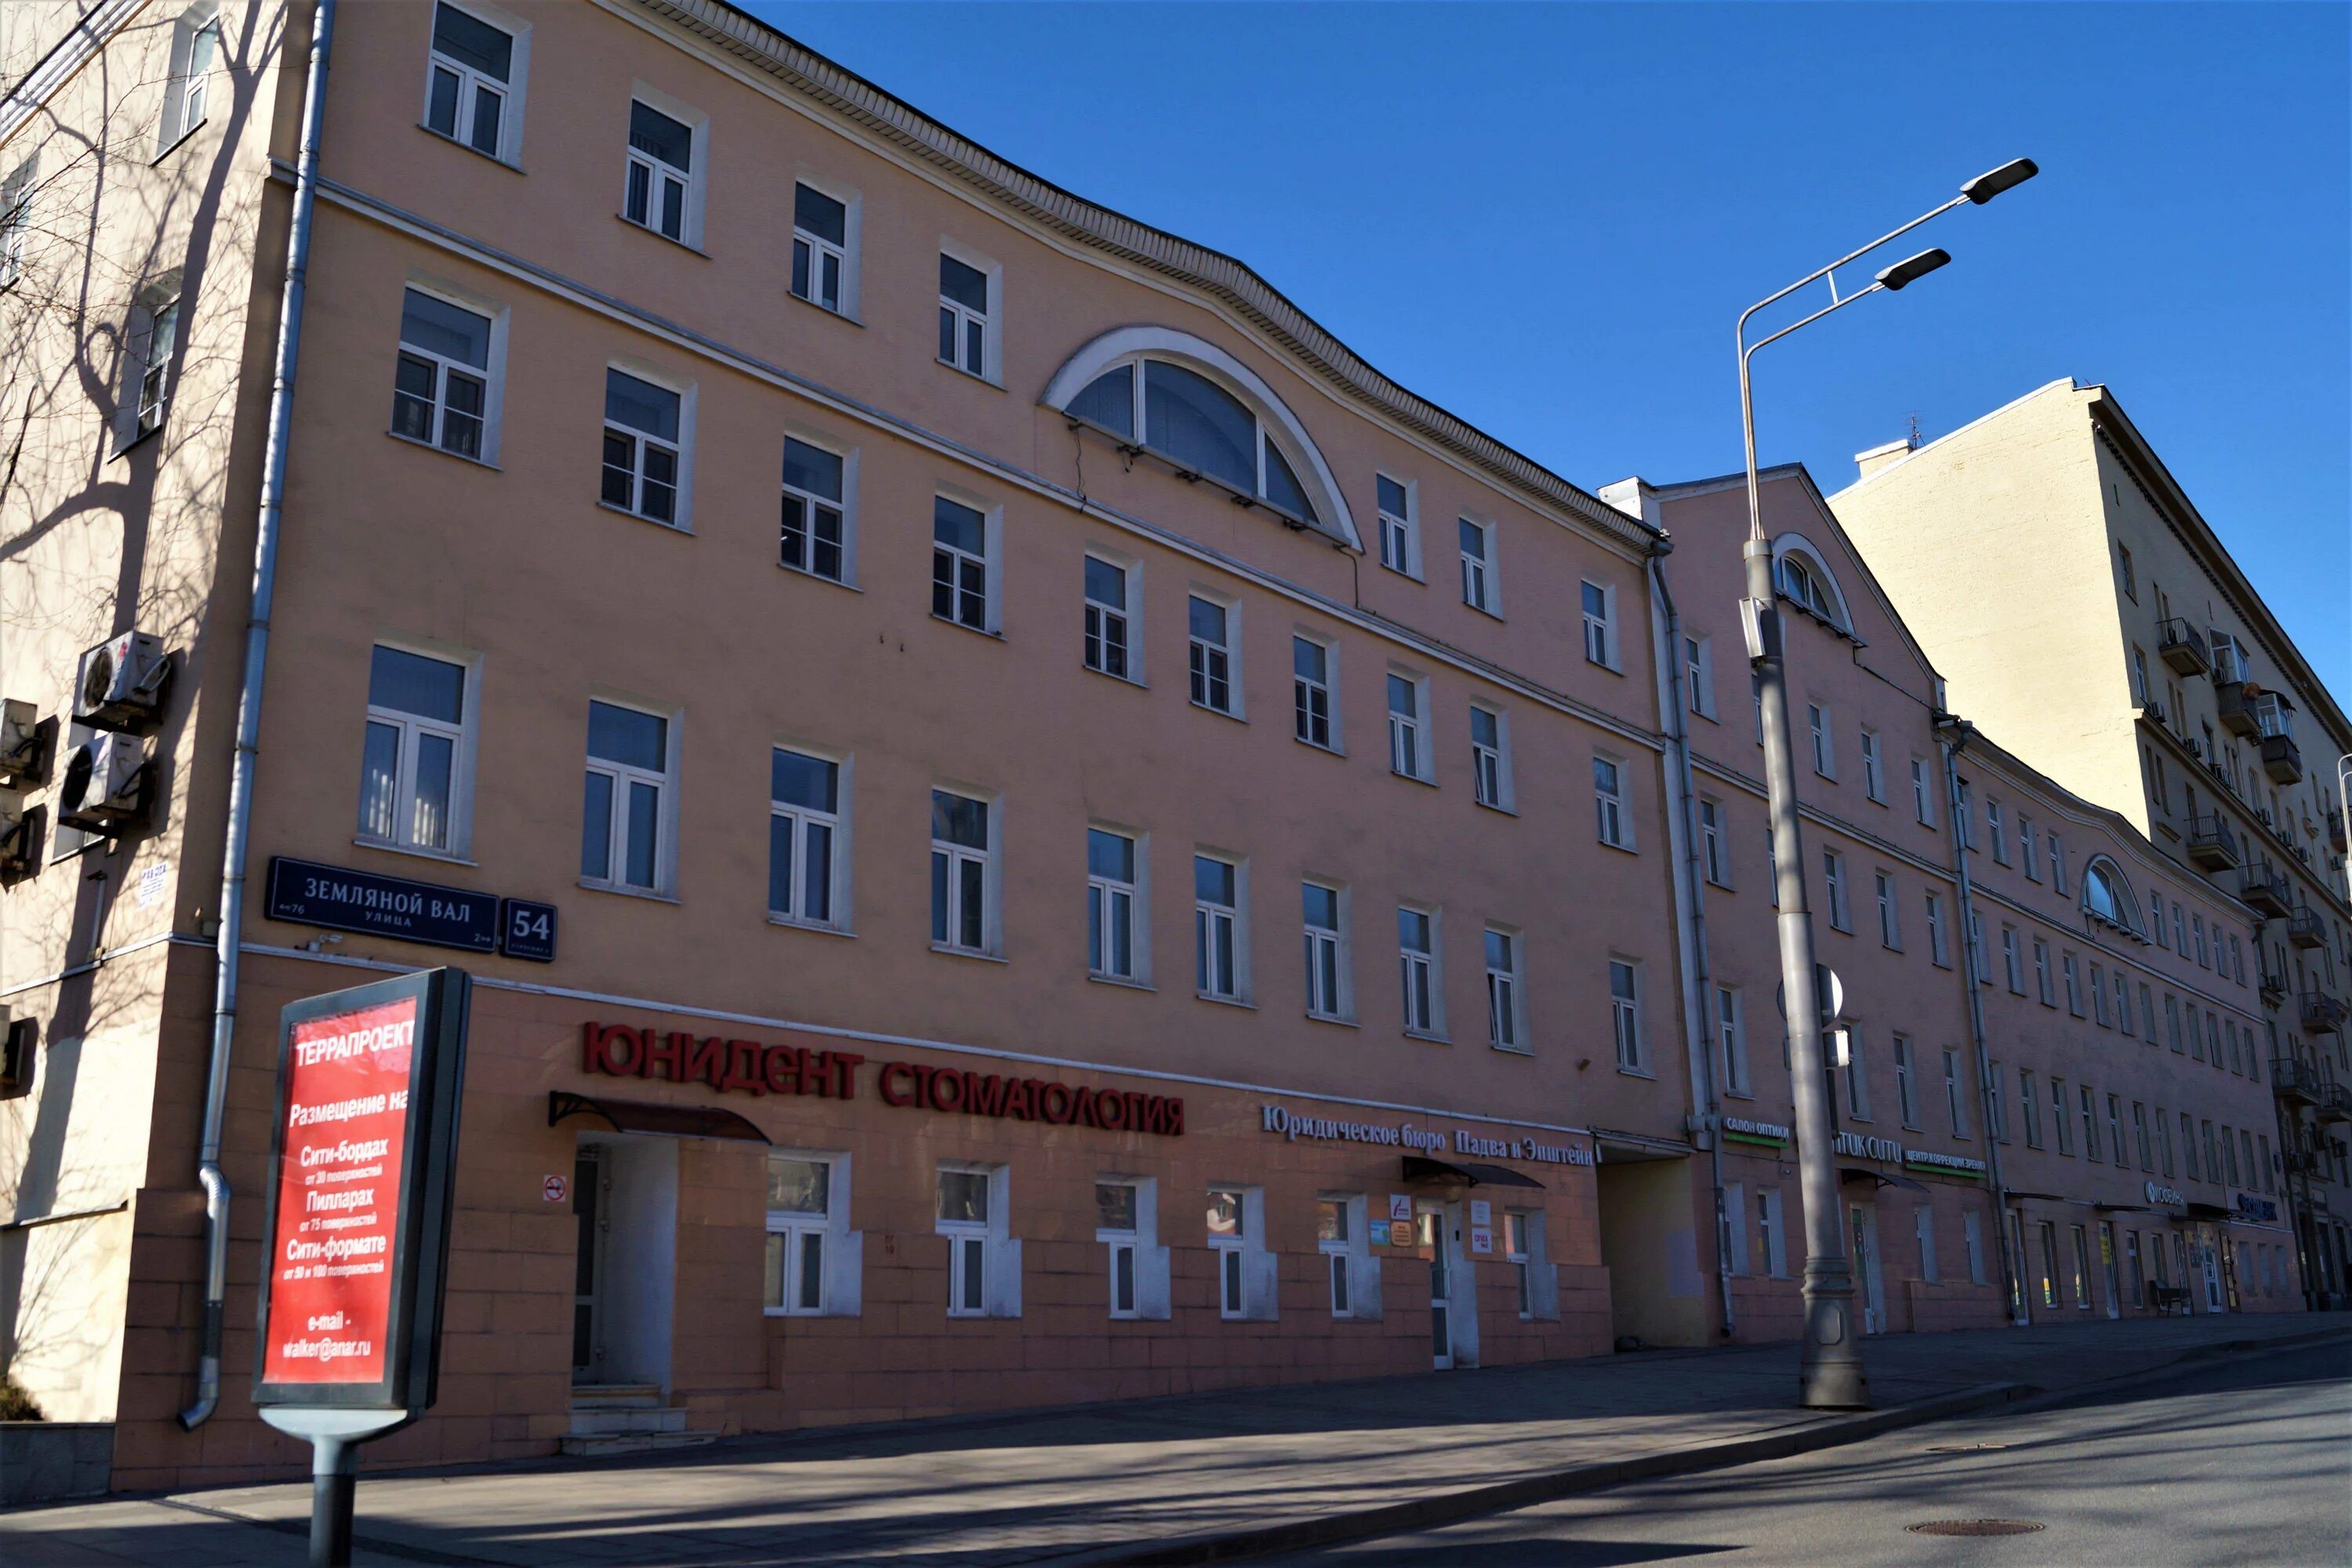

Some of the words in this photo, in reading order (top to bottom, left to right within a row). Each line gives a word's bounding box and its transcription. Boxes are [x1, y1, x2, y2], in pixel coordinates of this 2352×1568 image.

[304, 877, 423, 916] ЗЕМЛЯНОЙ
[430, 901, 470, 922] ВАЛ
[365, 910, 412, 927] УЛИЦА
[513, 909, 550, 941] 54
[474, 932, 481, 942] 2
[296, 1019, 416, 1067] ТЕРРАПРОЕКТ
[583, 1021, 864, 1100] ЮНИДЕНТ
[878, 1060, 1185, 1136] СТОМАТОЛОГИЯ
[289, 1095, 386, 1128] Размещение
[389, 1090, 408, 1112] на
[1261, 1105, 1399, 1147] Юридическое
[1400, 1124, 1446, 1156] бюро
[1454, 1129, 1507, 1159] Падва
[1510, 1142, 1522, 1159] и
[1523, 1136, 1593, 1167] Эпштейн
[1726, 1116, 1755, 1134] САЛОН
[1756, 1122, 1790, 1139] ОПТИКИ
[300, 1136, 389, 1168] Сити-бордах
[1907, 1149, 1928, 1163] ЦЕНТР
[1928, 1152, 1965, 1168] КОРРЕКЦИИ
[1964, 1157, 1987, 1171] ЗРЕНИЯ
[304, 1174, 316, 1186] от
[306, 1188, 375, 1213] Пилларах
[299, 1221, 310, 1233] от
[286, 1235, 387, 1262] Сити-формате
[283, 1268, 294, 1280] от
[307, 1310, 344, 1331] e-mail
